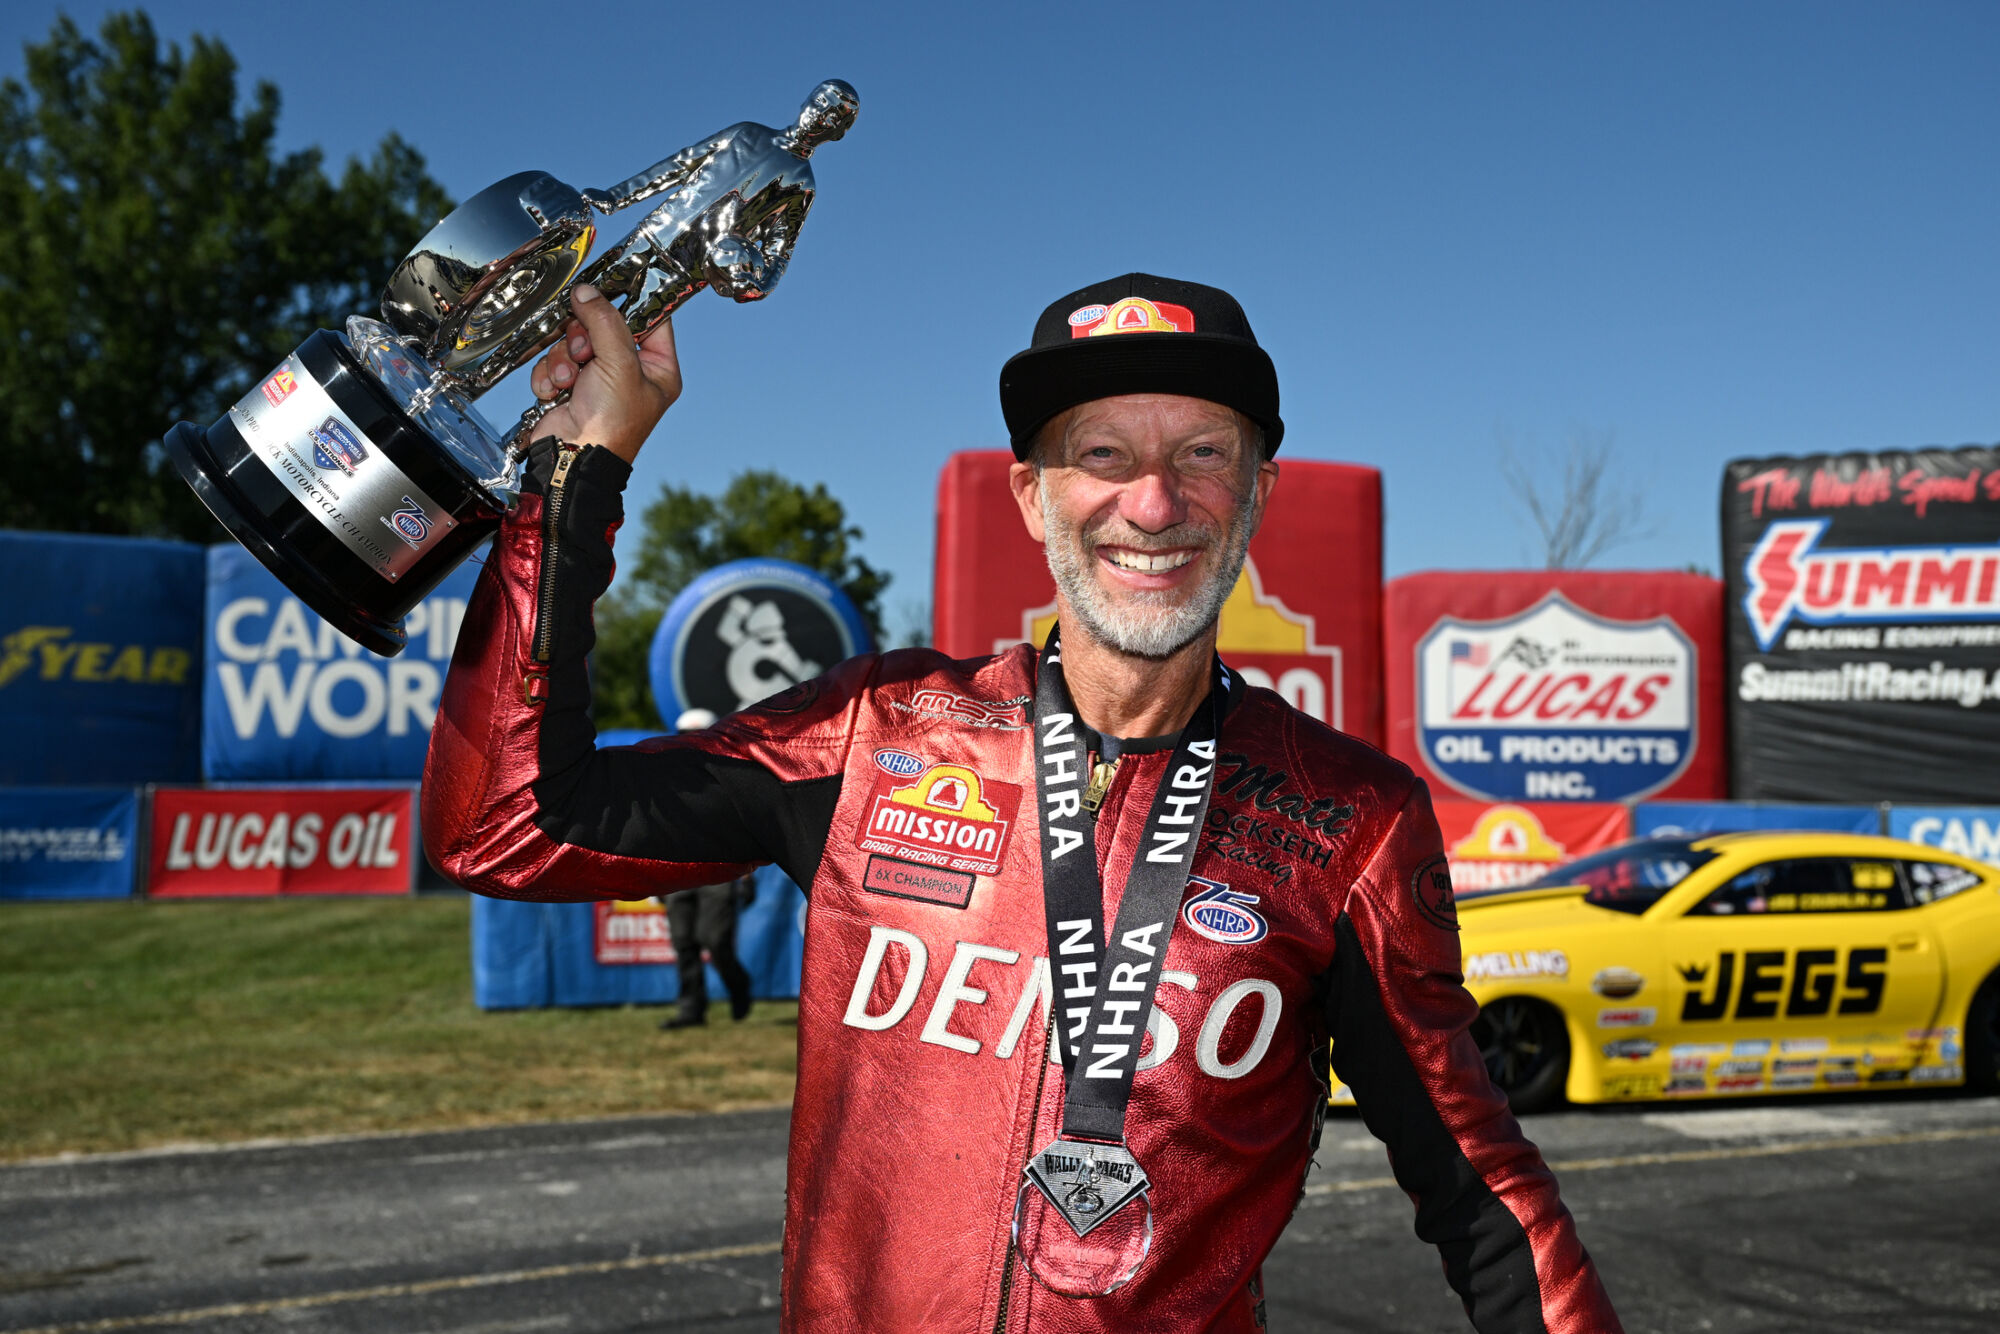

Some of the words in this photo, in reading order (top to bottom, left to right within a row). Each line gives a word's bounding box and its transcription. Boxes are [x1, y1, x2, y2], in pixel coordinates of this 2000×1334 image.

[320, 442, 353, 477] NATIONALS
[279, 458, 345, 522] MOTORCYCLE
[317, 477, 340, 501] Indiana
[391, 495, 435, 542] 75
[398, 516, 421, 537] NHRA
[1750, 524, 2000, 640] SUMMI
[217, 659, 442, 740] WOR
[1451, 672, 1671, 721] LUCAS
[1739, 661, 2000, 707] SummitRacing.
[890, 701, 919, 717] MATT
[880, 753, 921, 775] NHRA
[1435, 736, 1493, 763] OIL
[1502, 737, 1679, 765] PRODUCTS
[1041, 712, 1084, 861] NHRA
[1145, 739, 1216, 863] NHRA
[1217, 752, 1355, 837] Matt
[1525, 771, 1596, 798] INC.
[166, 812, 324, 870] LUCAS
[860, 839, 895, 855] DRAG
[896, 847, 950, 867] RACING
[950, 858, 999, 874] SERIES
[1202, 830, 1293, 888] Racing
[875, 868, 894, 882] 6X
[894, 872, 963, 895] CHAMPION
[1183, 875, 1269, 945] 75
[1201, 910, 1246, 932] NHRA
[1466, 950, 1569, 978] MELLING
[1680, 947, 1888, 1021] JEGS
[1085, 921, 1163, 1079] NHRA
[1096, 1160, 1135, 1184] PARKS
